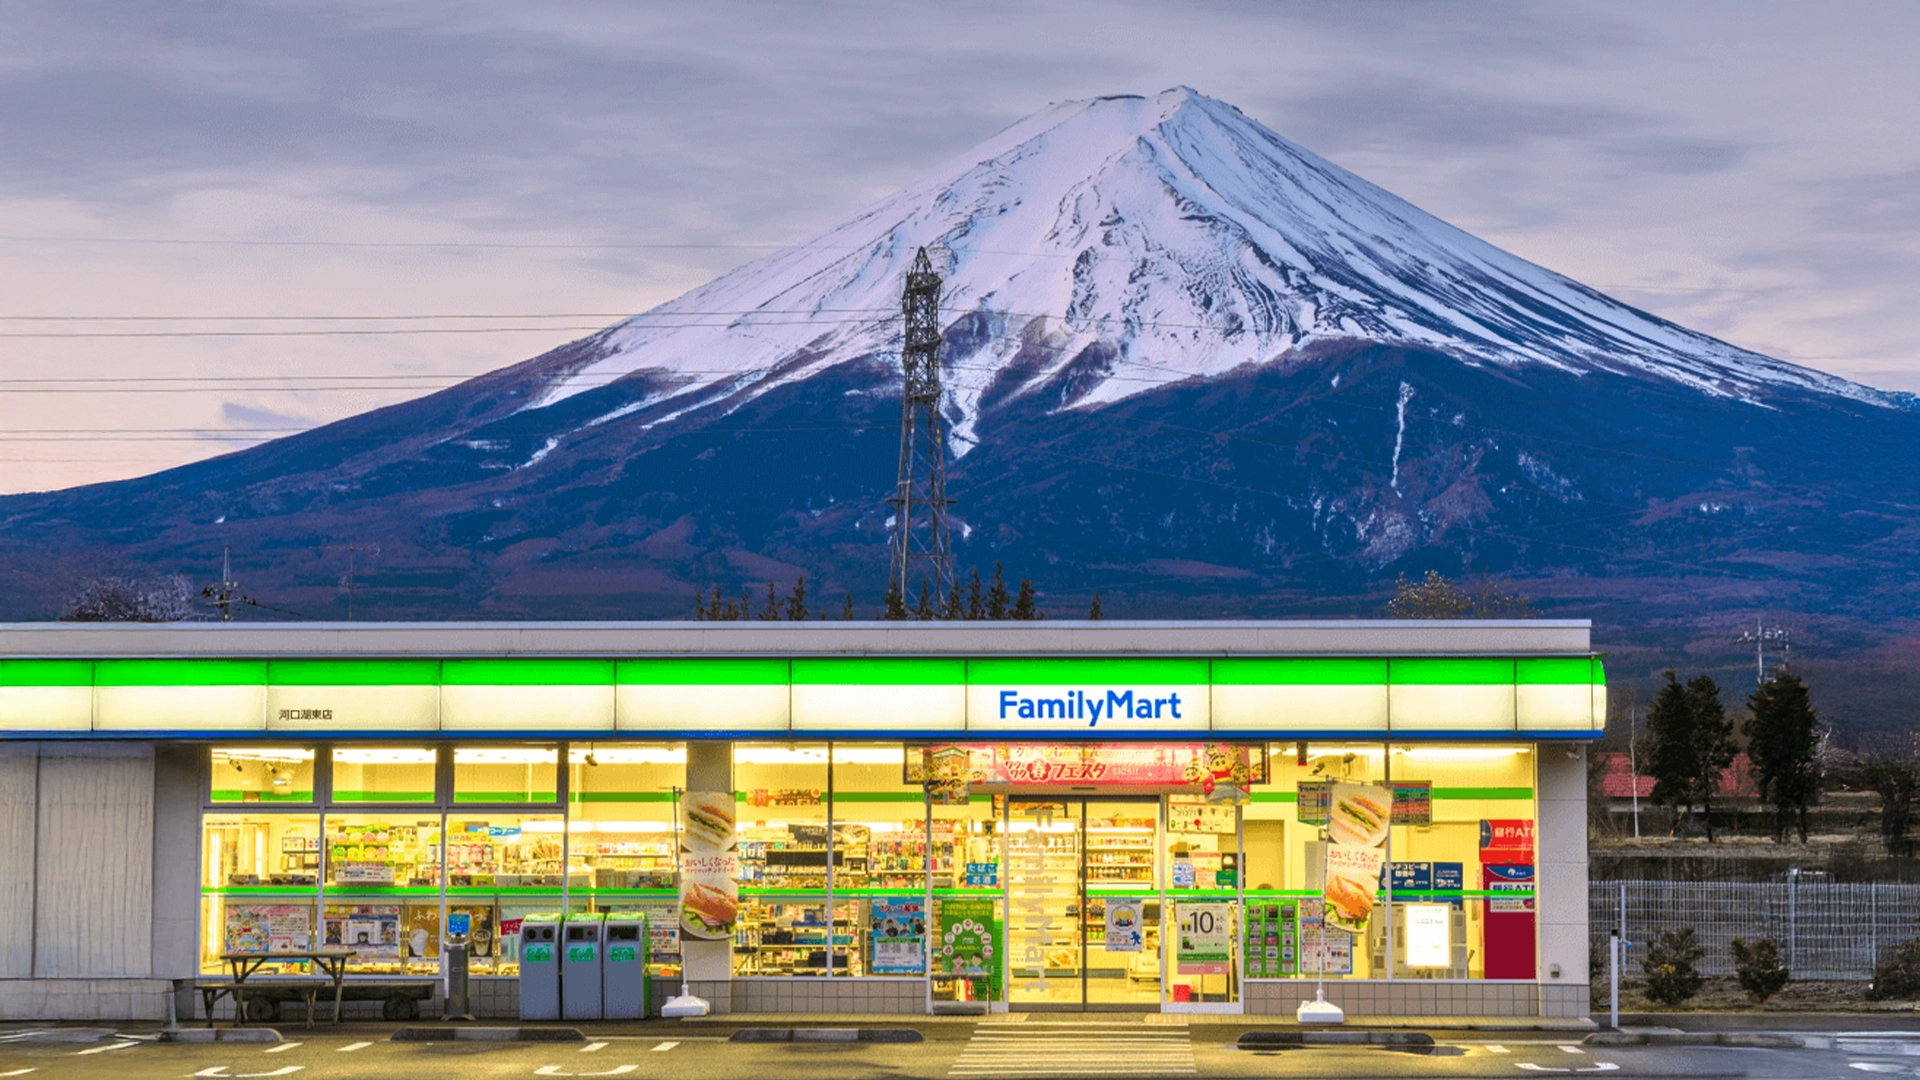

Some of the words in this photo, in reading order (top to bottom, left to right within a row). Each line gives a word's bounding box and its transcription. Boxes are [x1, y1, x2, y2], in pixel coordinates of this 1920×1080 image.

[278, 708, 333, 720] 河口湖東店
[1000, 690, 1182, 727] FamilyMart
[685, 857, 736, 867] おいしくなった
[968, 864, 996, 872] たばこ
[972, 874, 991, 883] お酒
[1017, 809, 1053, 992] FamilyMart
[1190, 911, 1214, 934] 10
